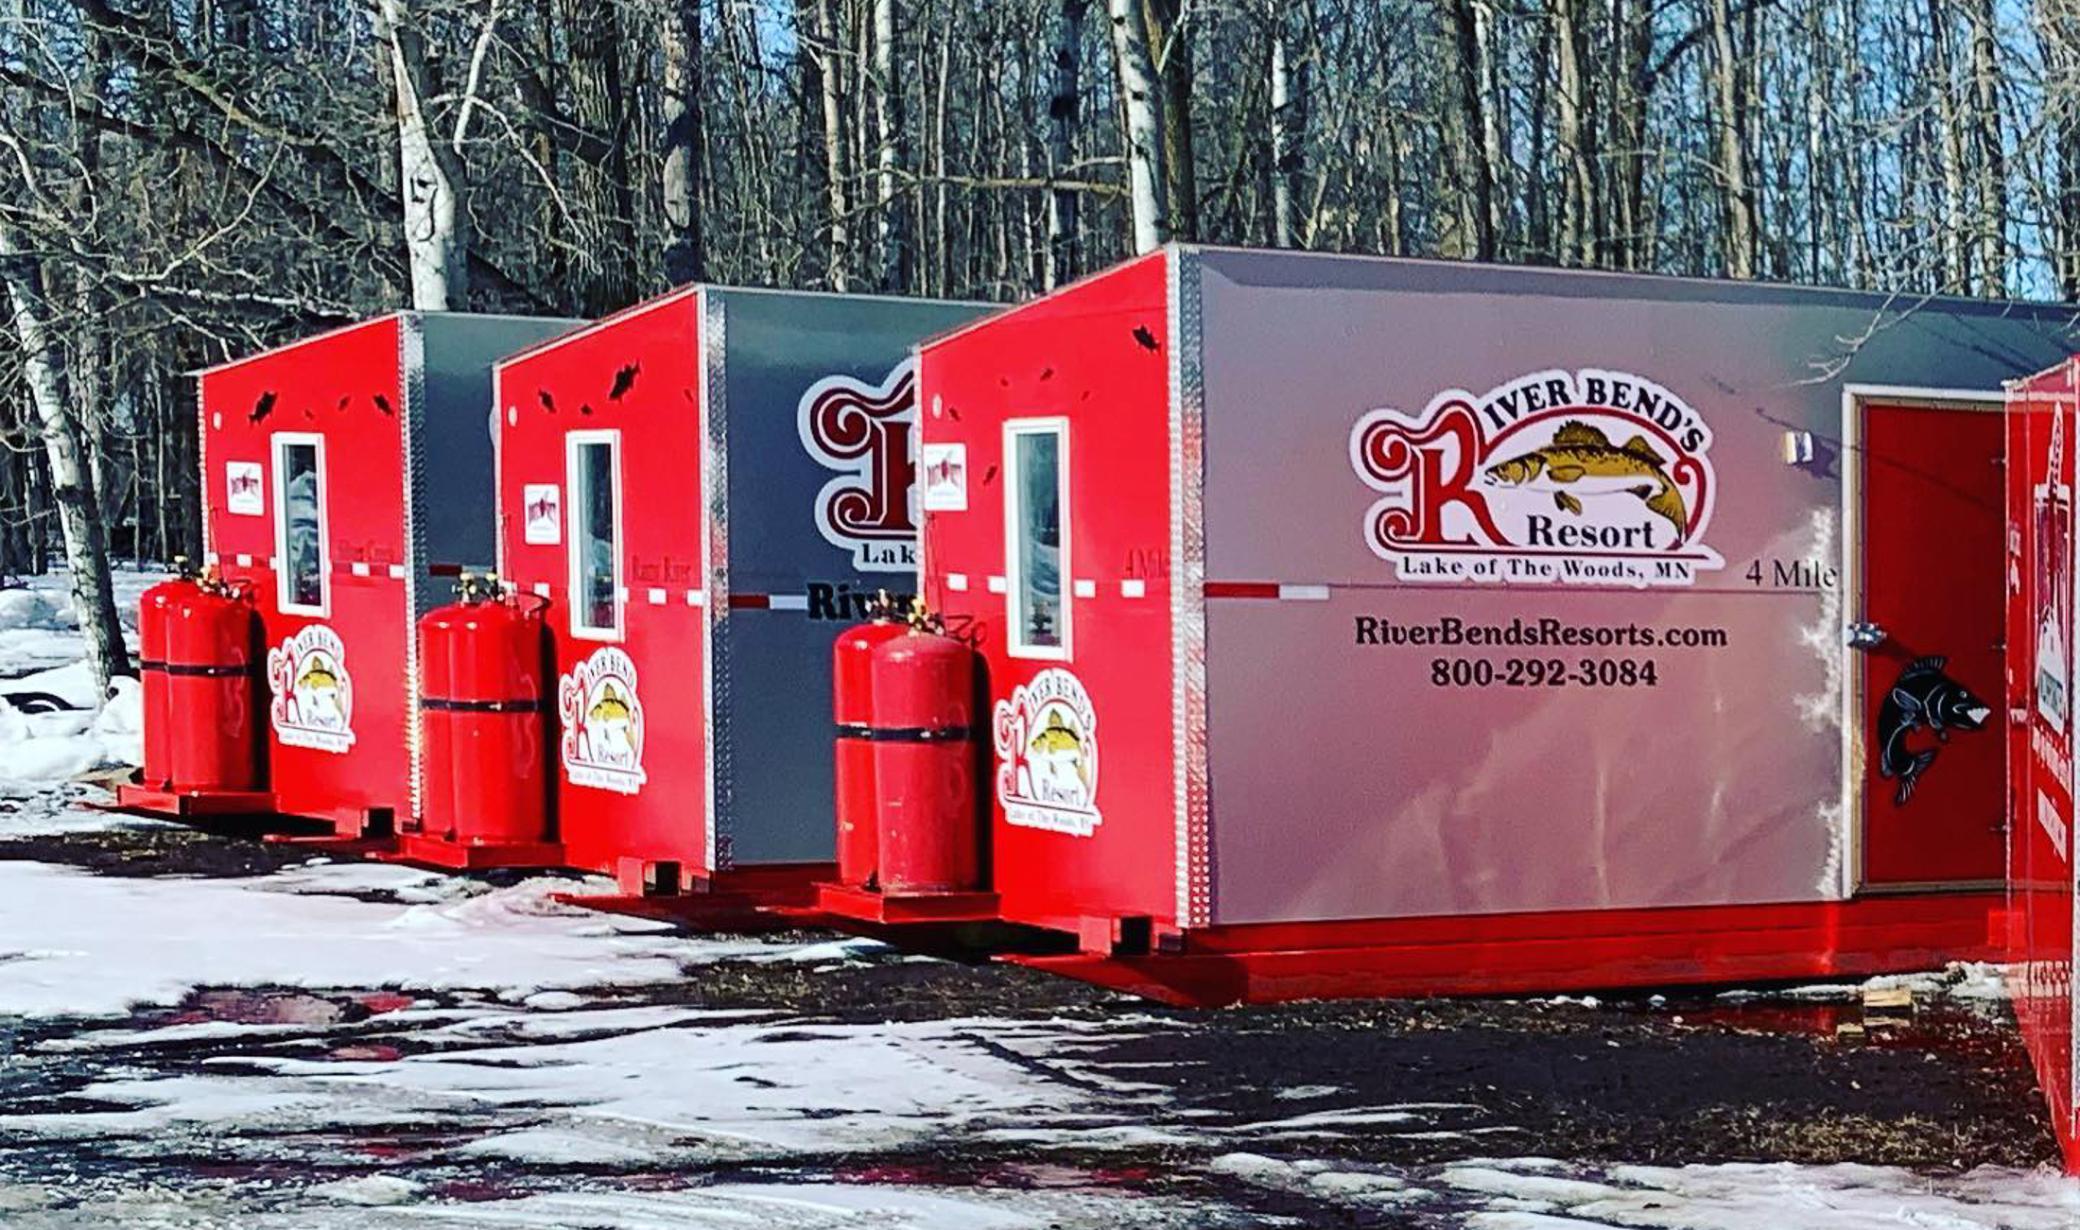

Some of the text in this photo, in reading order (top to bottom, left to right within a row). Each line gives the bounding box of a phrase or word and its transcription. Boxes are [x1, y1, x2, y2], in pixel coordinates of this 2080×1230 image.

[1361, 377, 1705, 551] RIVER BEND'S
[1526, 513, 1655, 549] Resort
[862, 543, 917, 565] Lak
[1403, 555, 1691, 581] Lake of The Woods, MN
[1745, 559, 1838, 588] 4 Mile
[1355, 616, 1728, 647] RiverBendsResorts.com
[1431, 658, 1658, 687] 800-292-3084
